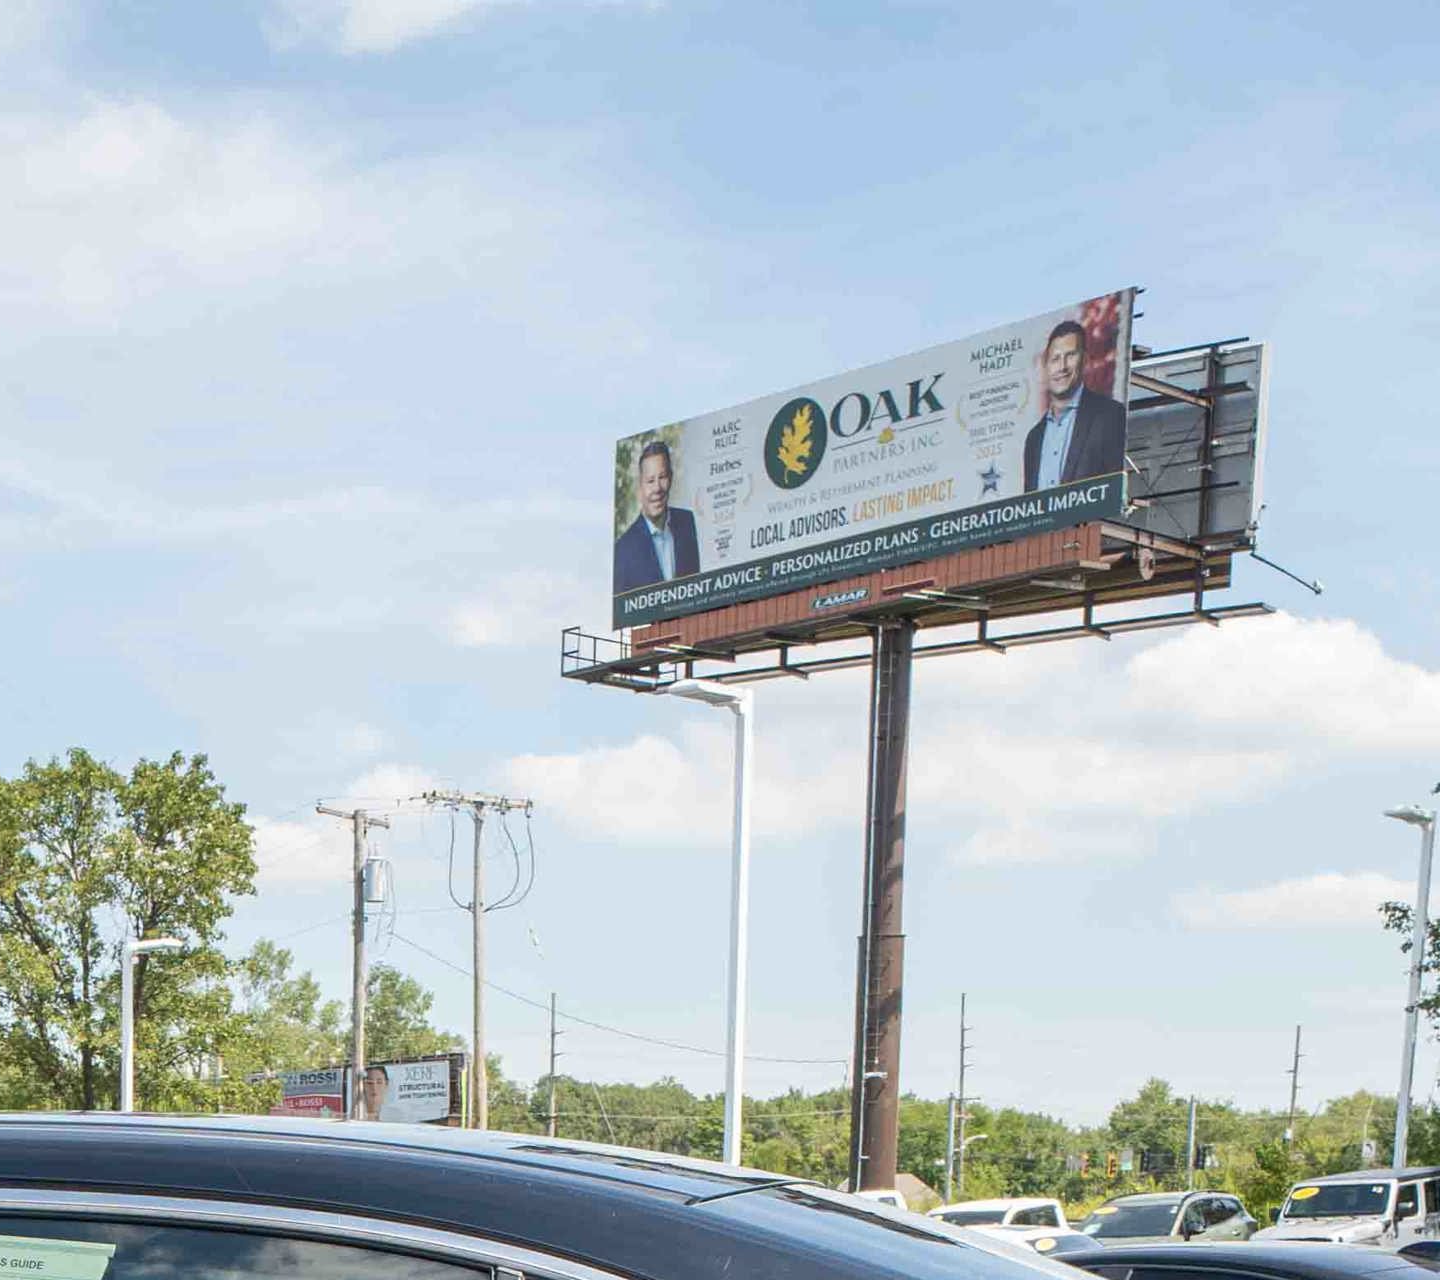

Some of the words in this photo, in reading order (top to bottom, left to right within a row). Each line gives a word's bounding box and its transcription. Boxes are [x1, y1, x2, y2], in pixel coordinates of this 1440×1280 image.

[970, 337, 1025, 363] MICHAEL
[979, 354, 1013, 374] HADT
[829, 371, 946, 438] OAK
[712, 419, 742, 437] MARC
[714, 433, 738, 450] RUIZ
[710, 459, 743, 477] Forbes
[750, 521, 785, 549] LOCAL
[788, 507, 851, 539] ADVISORS.
[852, 491, 904, 523] LASTING
[624, 578, 713, 614] INDEPENDENT
[713, 566, 763, 592] ADVICE
[771, 539, 872, 577] PERSONALIZED
[874, 527, 919, 553] PLANS
[929, 498, 1046, 539] GENERATIONAL
[1047, 483, 1110, 513] IMPACT
[814, 589, 867, 610] LAMAR
[299, 1071, 338, 1086] ROSSI
[10, 1258, 46, 1271] GUIDE
